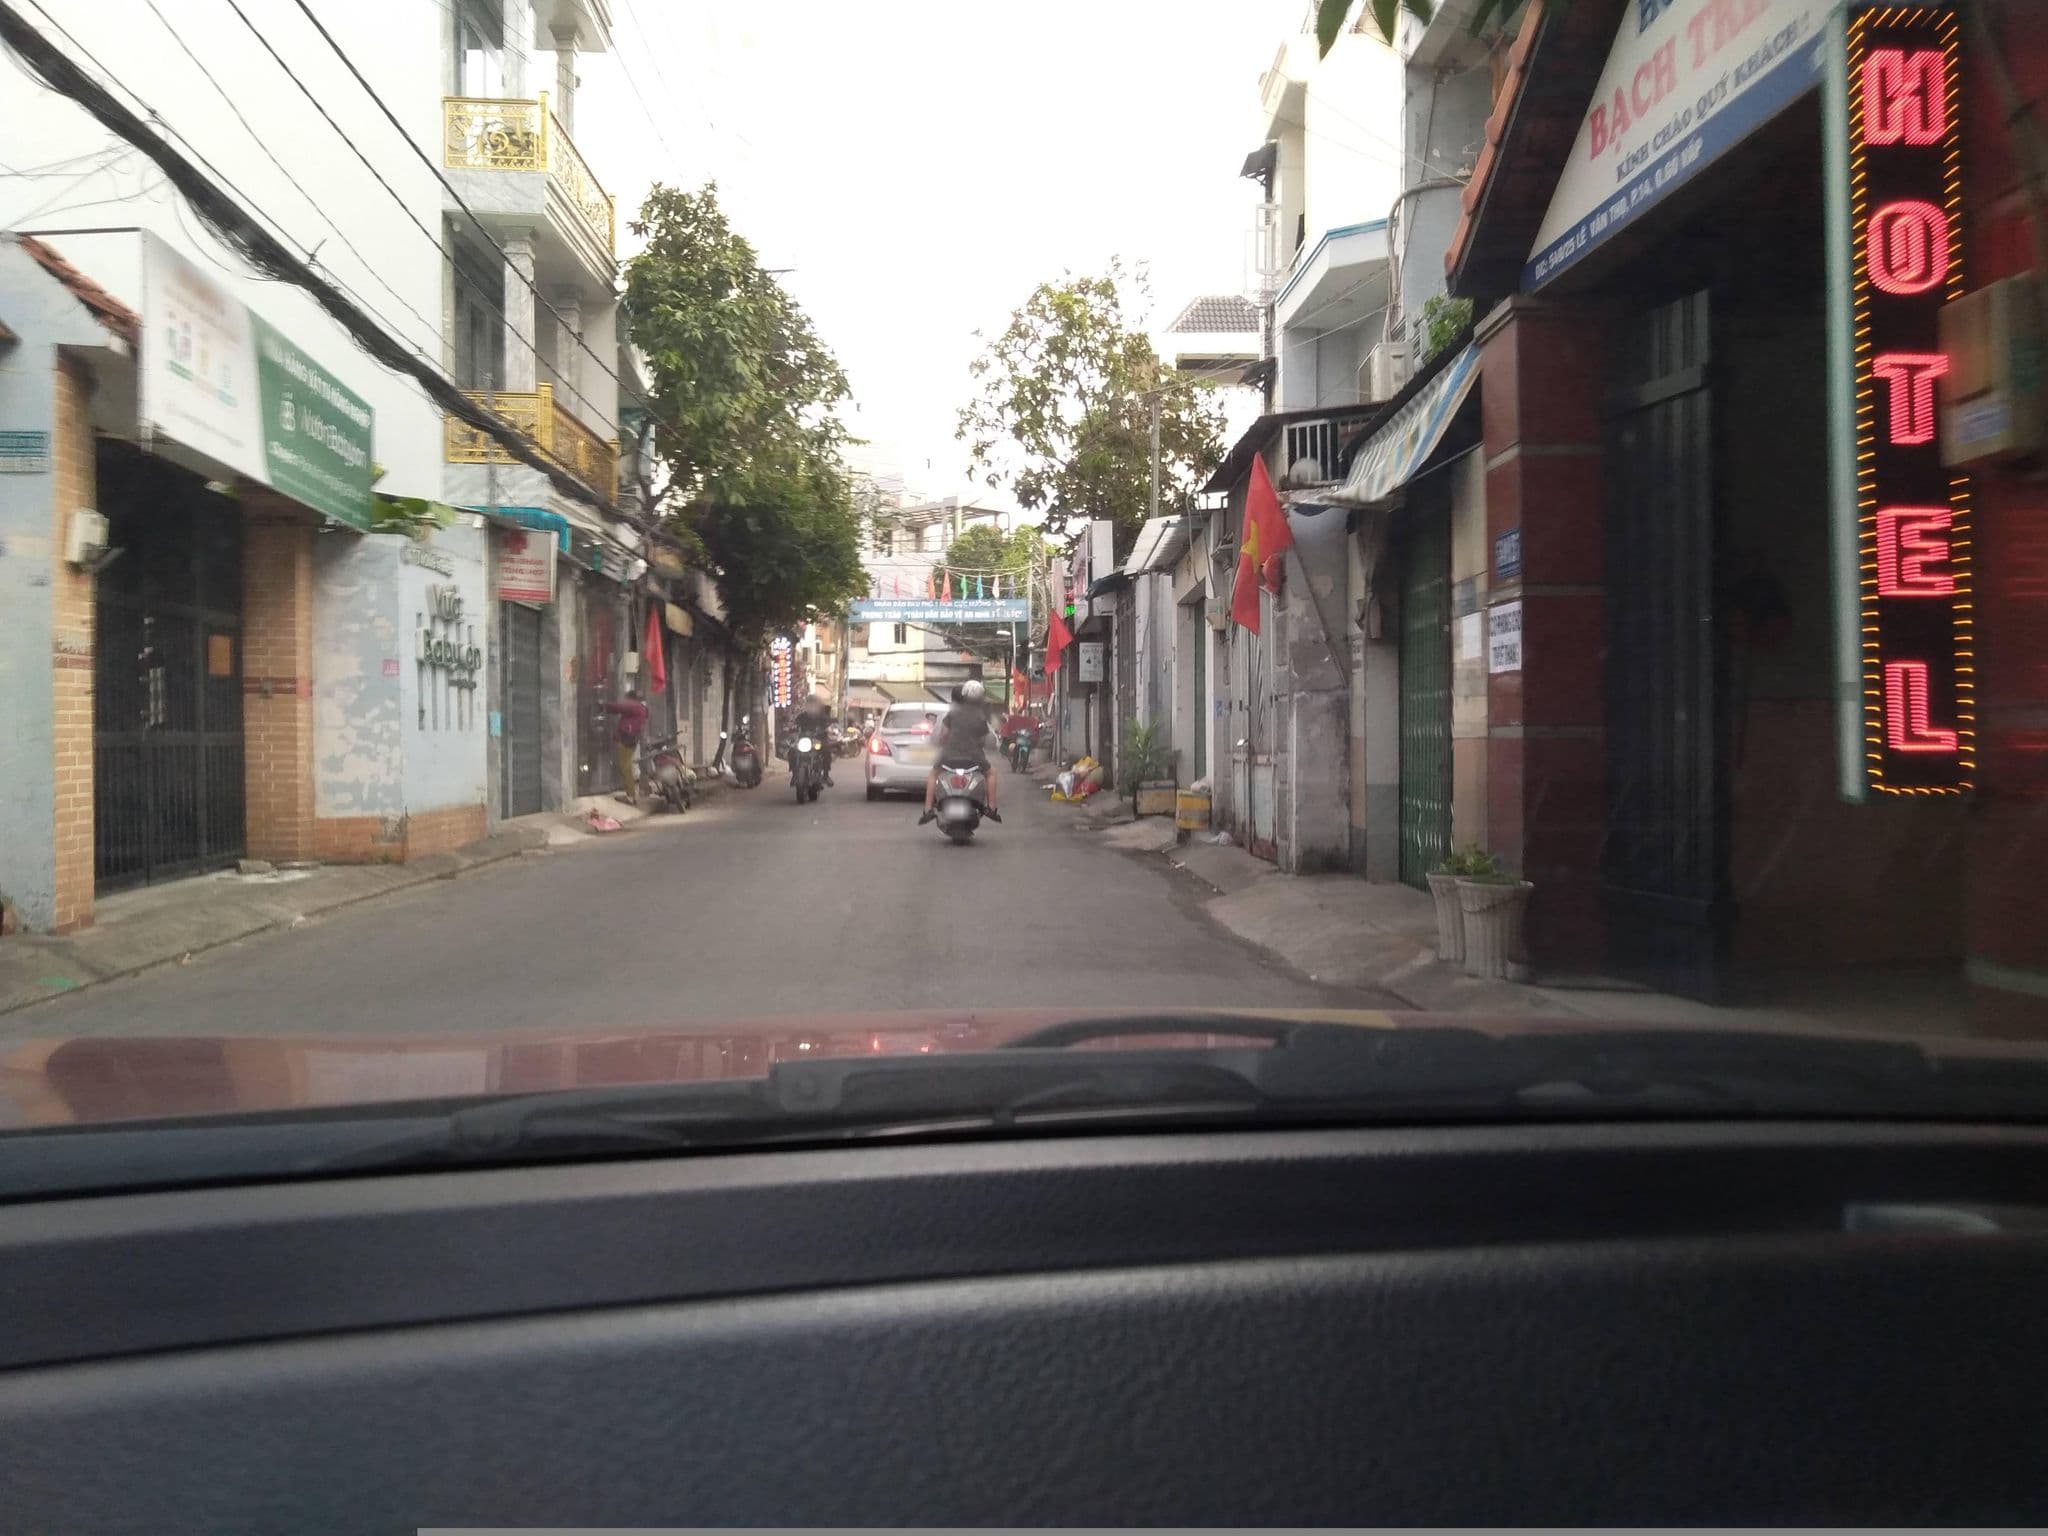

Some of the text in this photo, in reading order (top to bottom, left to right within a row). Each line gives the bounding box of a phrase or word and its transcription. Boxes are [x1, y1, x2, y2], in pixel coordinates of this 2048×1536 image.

[1590, 36, 1677, 161] BẠCH
[1652, 108, 1692, 151] CHÀO
[1696, 69, 1729, 120] QUÝ
[1862, 49, 1957, 752] HOTEL
